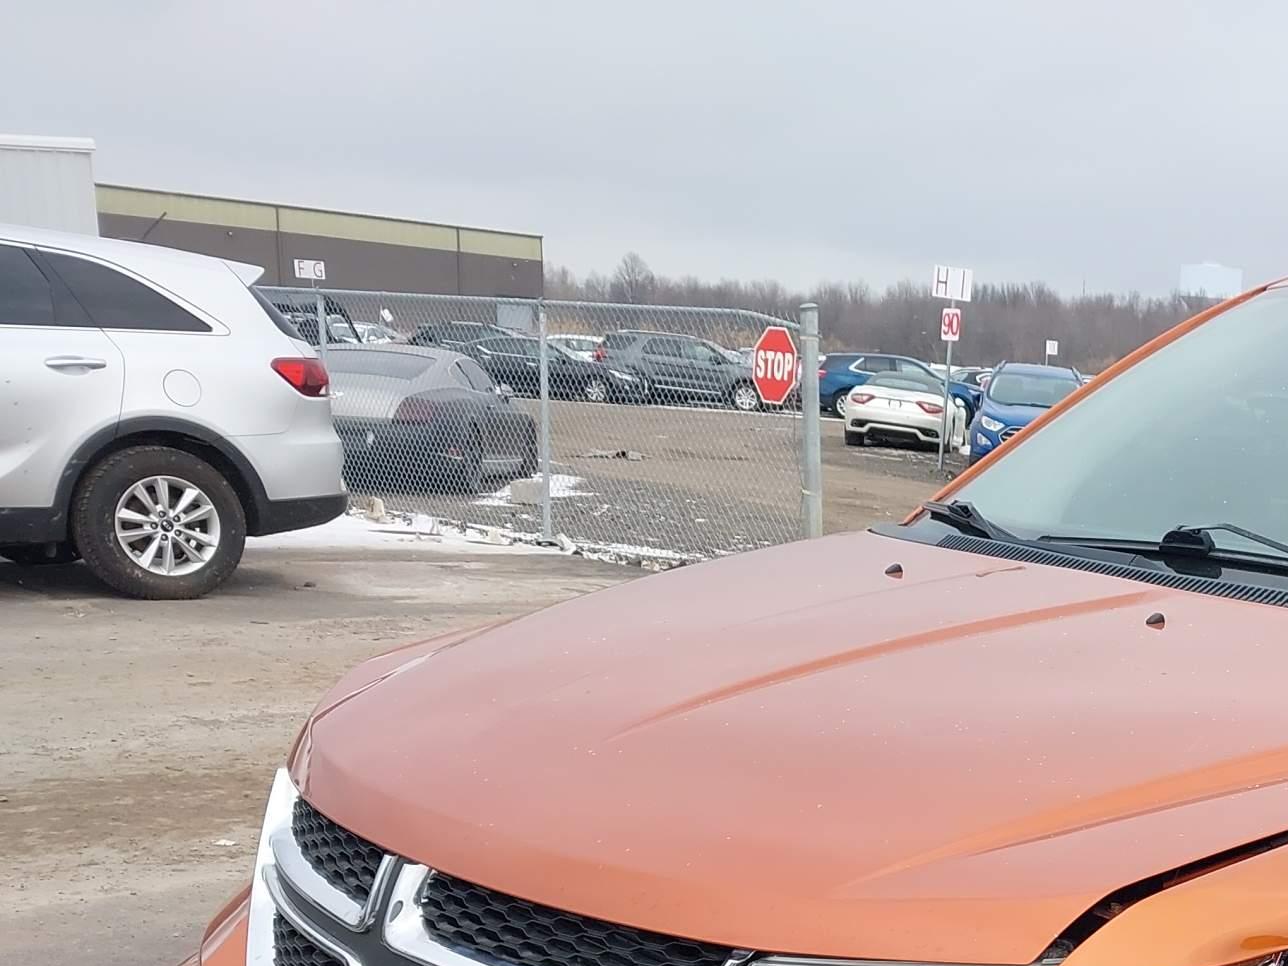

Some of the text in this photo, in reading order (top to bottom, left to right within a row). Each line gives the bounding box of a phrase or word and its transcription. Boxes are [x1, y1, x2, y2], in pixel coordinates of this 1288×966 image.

[298, 260, 323, 278] F G
[935, 266, 949, 296] H
[942, 312, 961, 336] 90
[756, 349, 794, 381] STOP
